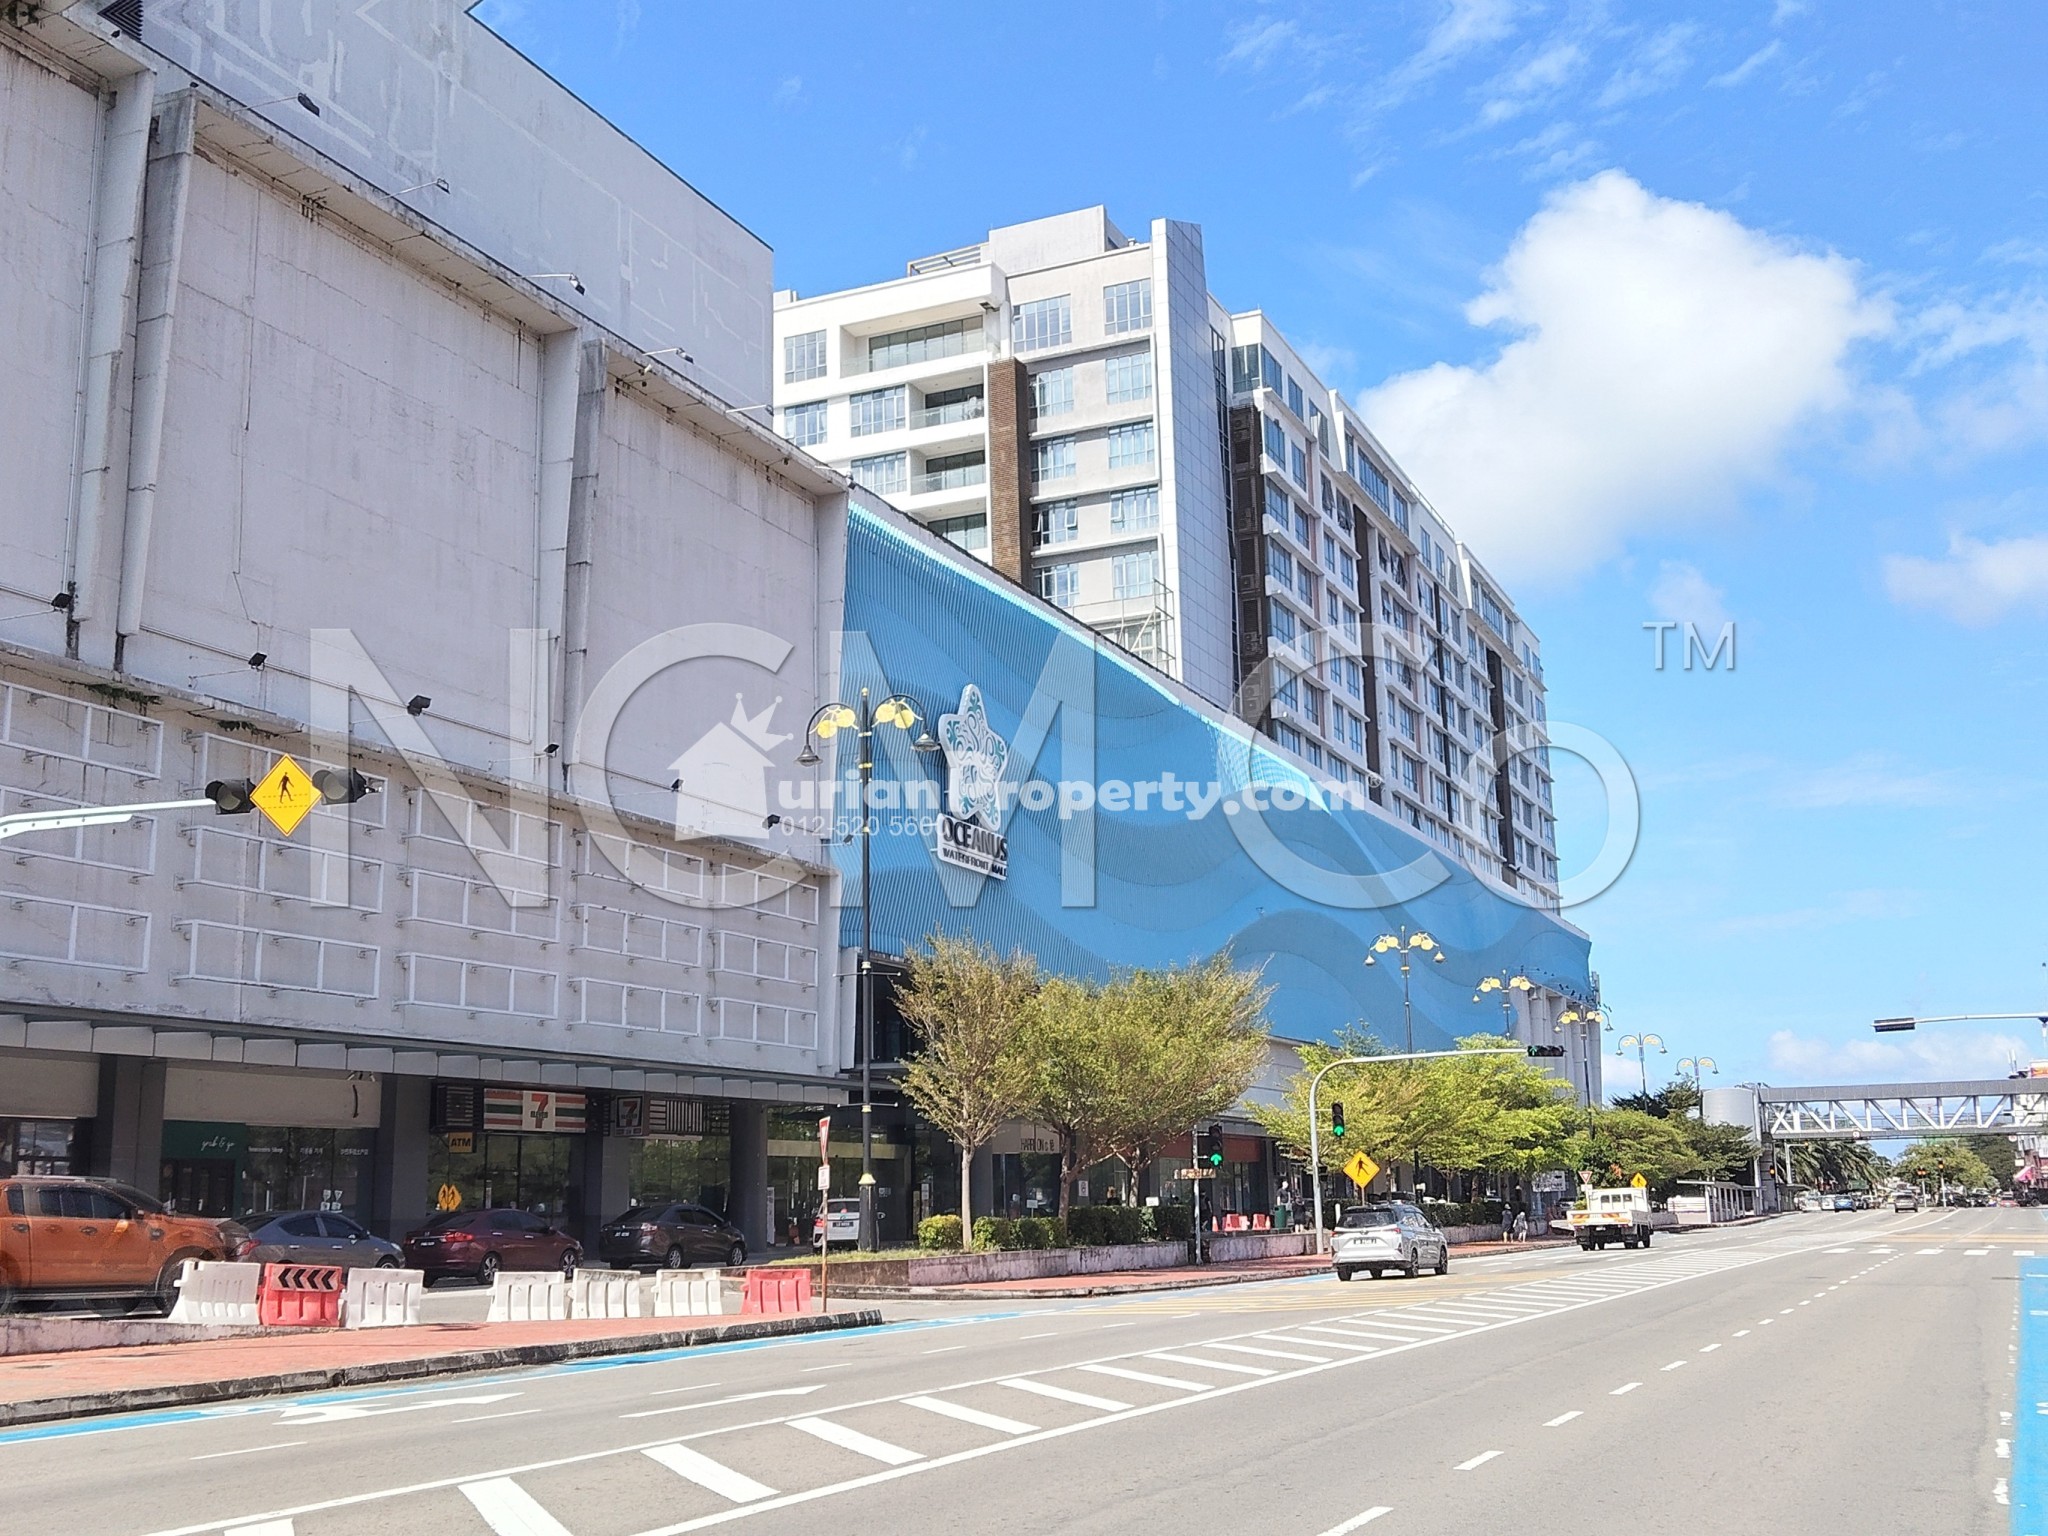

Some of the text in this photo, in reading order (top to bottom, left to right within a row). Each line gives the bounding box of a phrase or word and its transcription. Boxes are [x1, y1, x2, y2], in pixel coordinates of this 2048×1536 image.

[942, 817, 1008, 861] OCEANUS
[942, 847, 990, 871] WATERFRONT
[531, 1093, 549, 1129] 7
[451, 1137, 471, 1147] ATM
